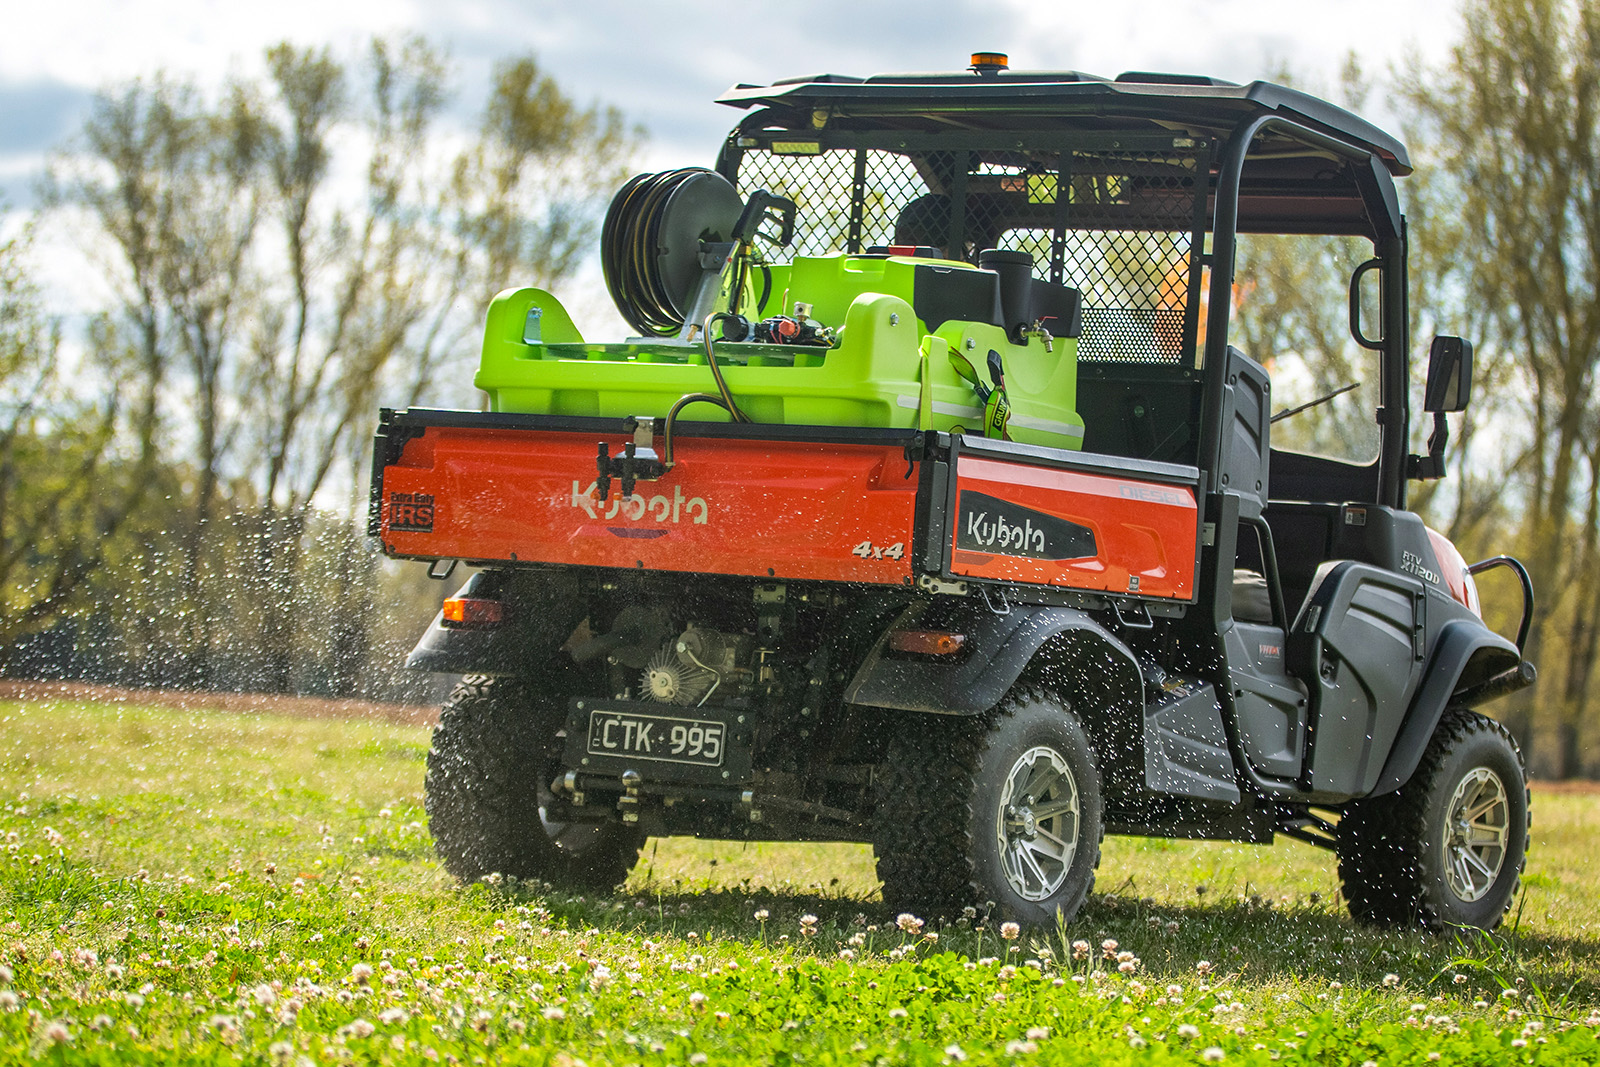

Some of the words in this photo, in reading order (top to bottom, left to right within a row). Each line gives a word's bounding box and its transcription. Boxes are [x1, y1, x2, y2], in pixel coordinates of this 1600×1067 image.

[1119, 485, 1189, 506] DIESEL
[391, 505, 432, 525] IRS
[967, 511, 1045, 552] Kubota
[852, 541, 904, 561] 4x4
[1403, 551, 1422, 565] RTV
[1400, 559, 1440, 585] X1120D
[592, 718, 603, 747] VIC
[602, 719, 654, 752] CTK
[669, 725, 722, 758] 995
